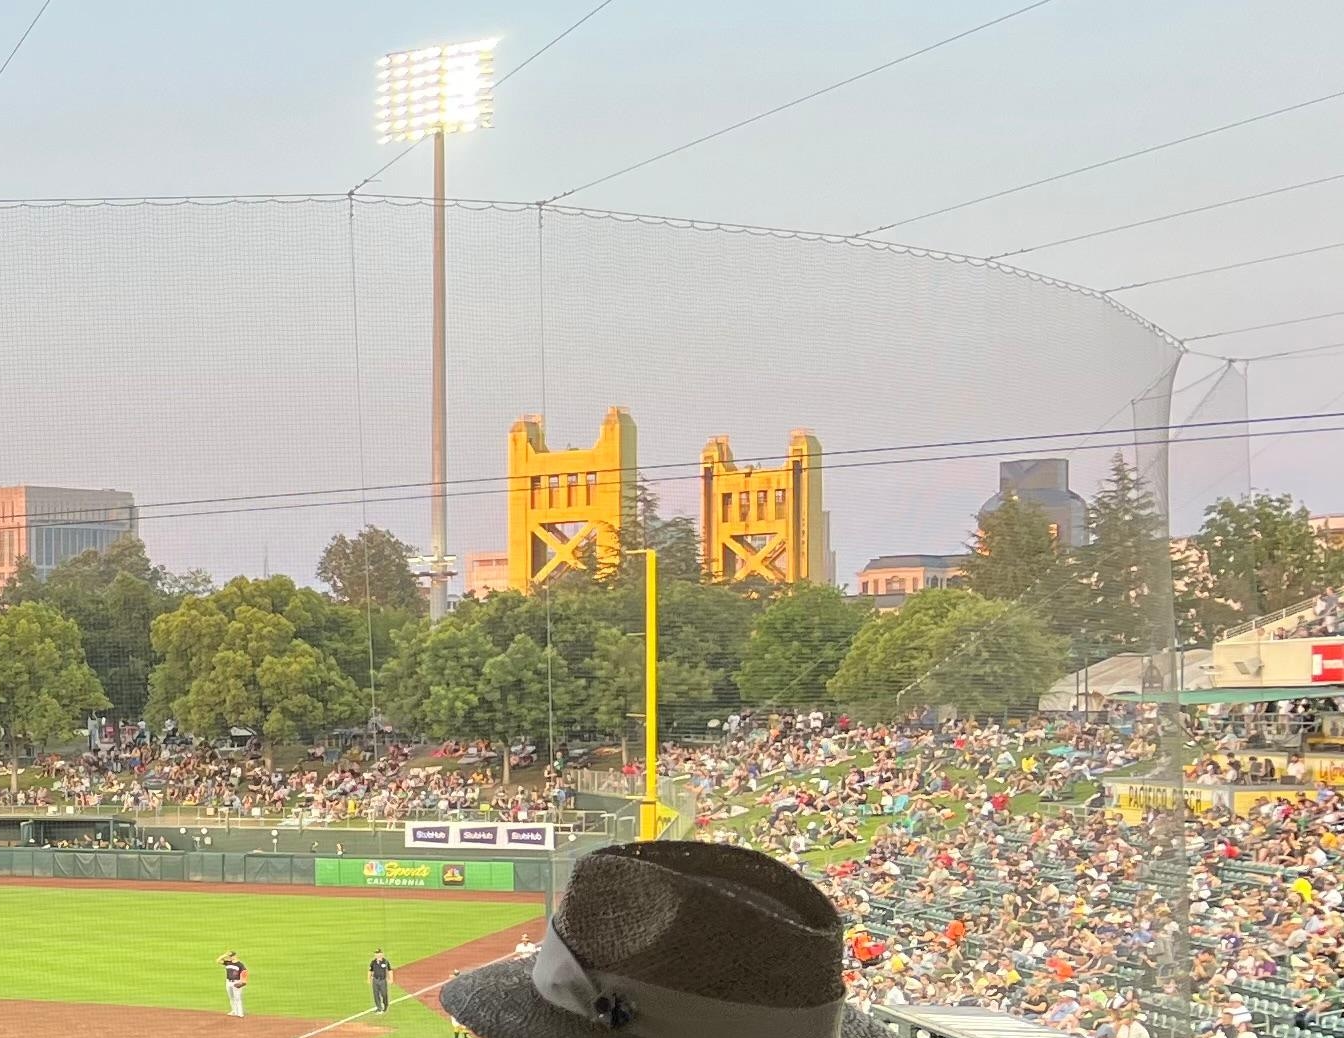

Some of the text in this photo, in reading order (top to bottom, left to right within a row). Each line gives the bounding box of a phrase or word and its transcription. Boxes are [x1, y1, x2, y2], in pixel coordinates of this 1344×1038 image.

[416, 830, 542, 842] StubHub StubHub StubHub
[384, 861, 432, 878] Sports
[366, 877, 425, 886] CALIFORNIA
